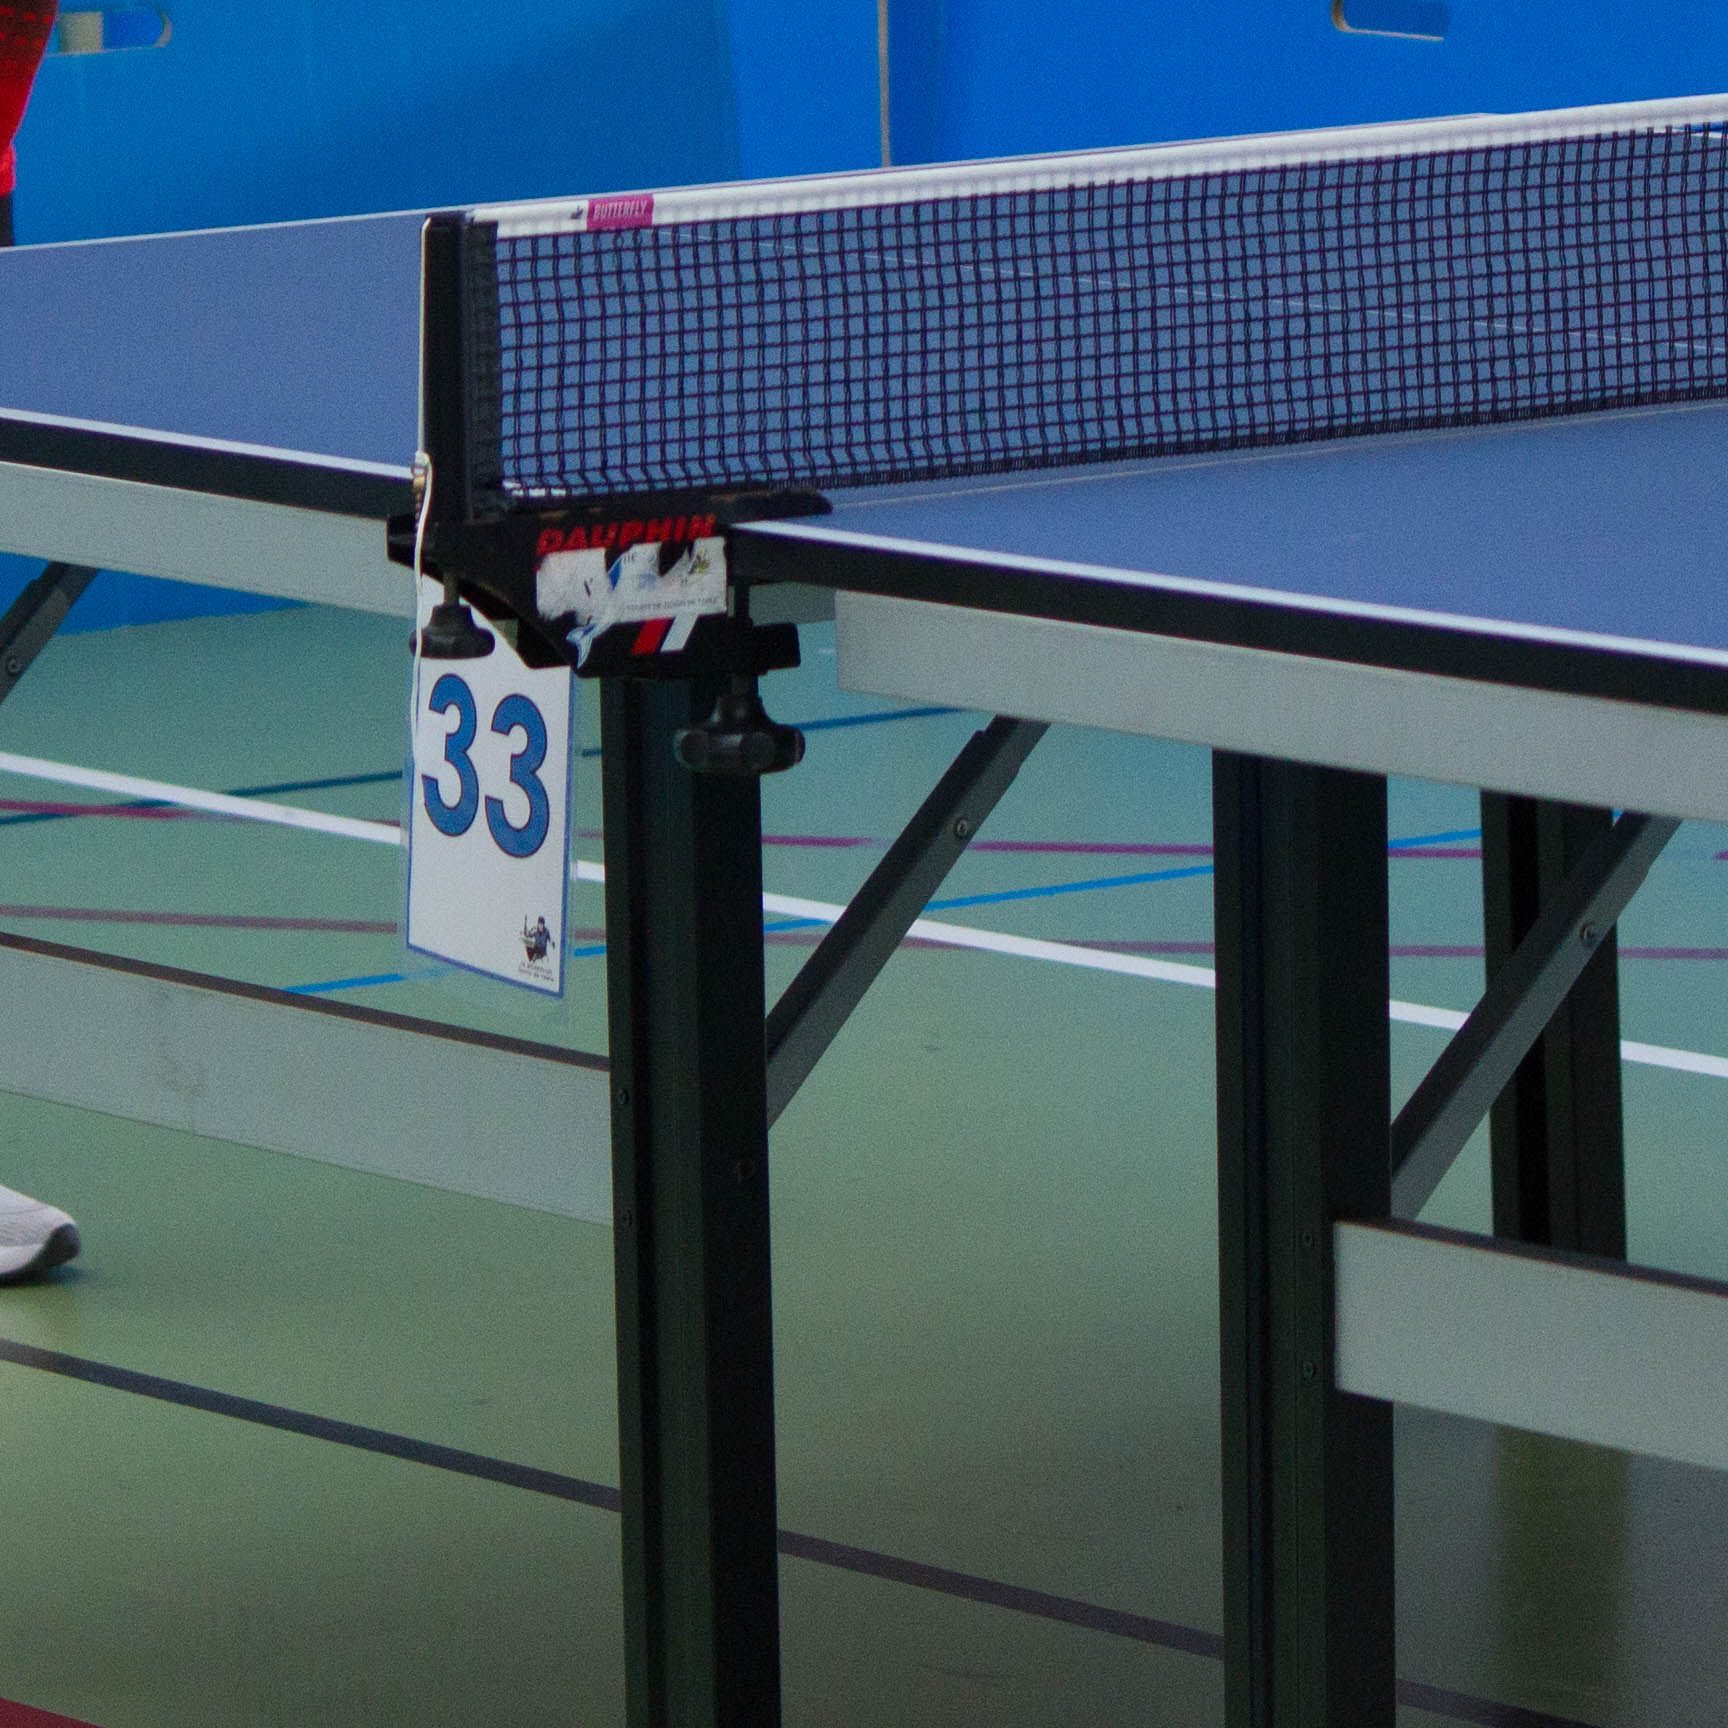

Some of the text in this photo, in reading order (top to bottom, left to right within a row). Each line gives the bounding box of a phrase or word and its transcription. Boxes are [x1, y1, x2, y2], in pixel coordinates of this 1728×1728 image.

[593, 199, 649, 222] BUTTERFLY
[536, 513, 718, 557] DAUPHIN
[420, 672, 551, 859] 33
